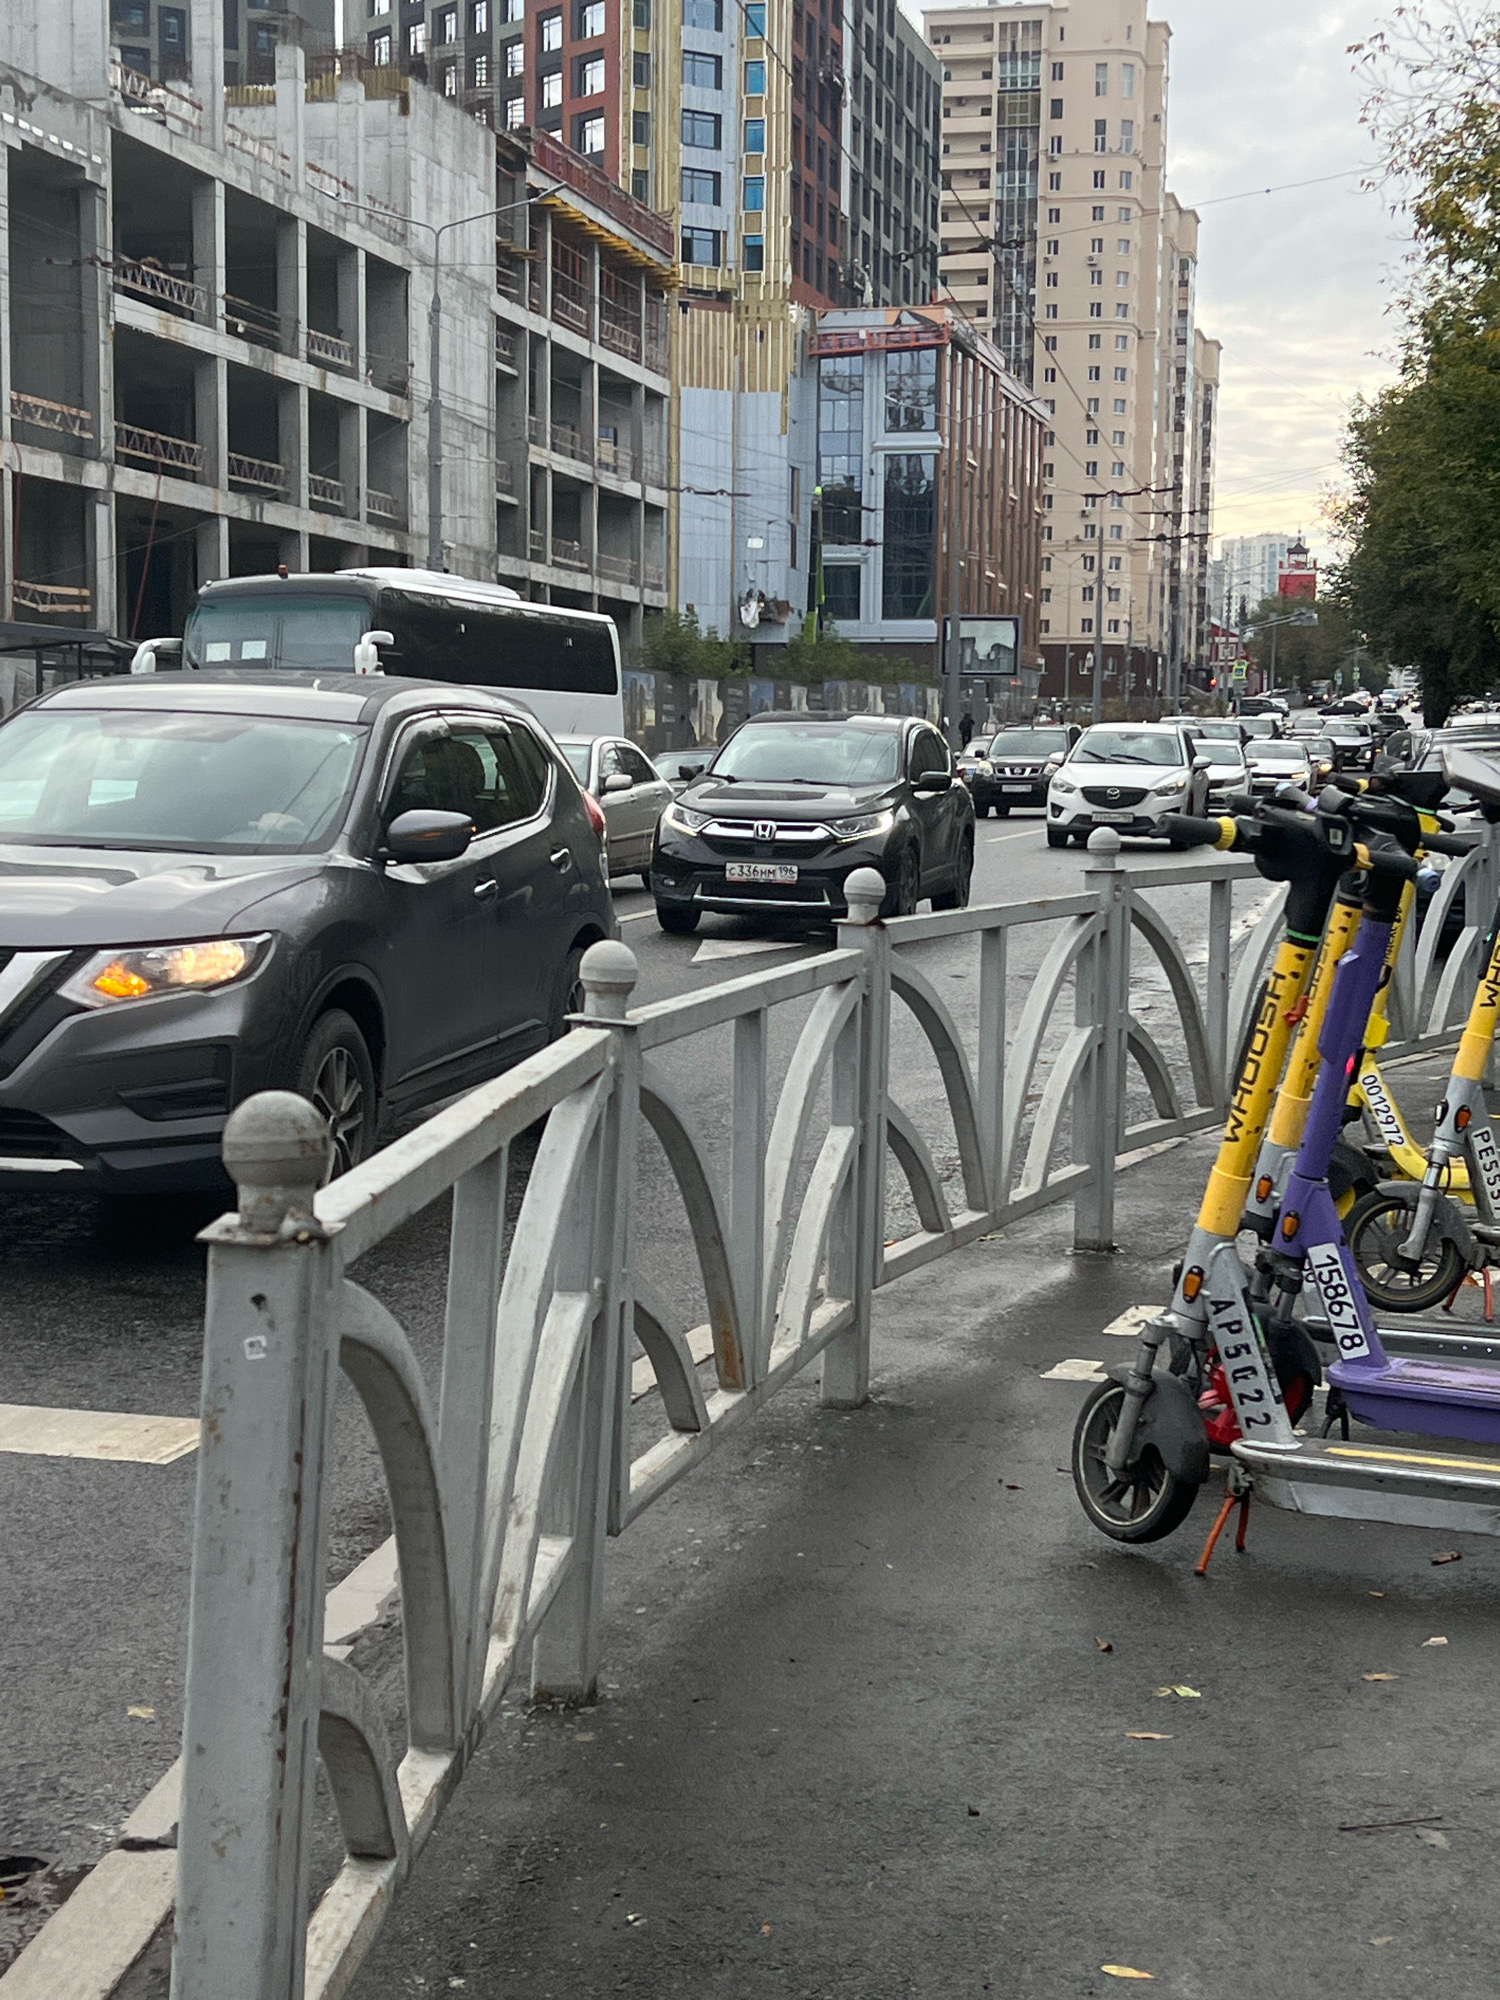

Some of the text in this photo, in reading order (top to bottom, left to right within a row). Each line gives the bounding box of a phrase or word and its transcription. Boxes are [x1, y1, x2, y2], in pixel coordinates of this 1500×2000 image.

[1224, 971, 1286, 1143] WHOOSH
[1361, 1074, 1405, 1147] 0012972
[1314, 1254, 1365, 1351] 158678
